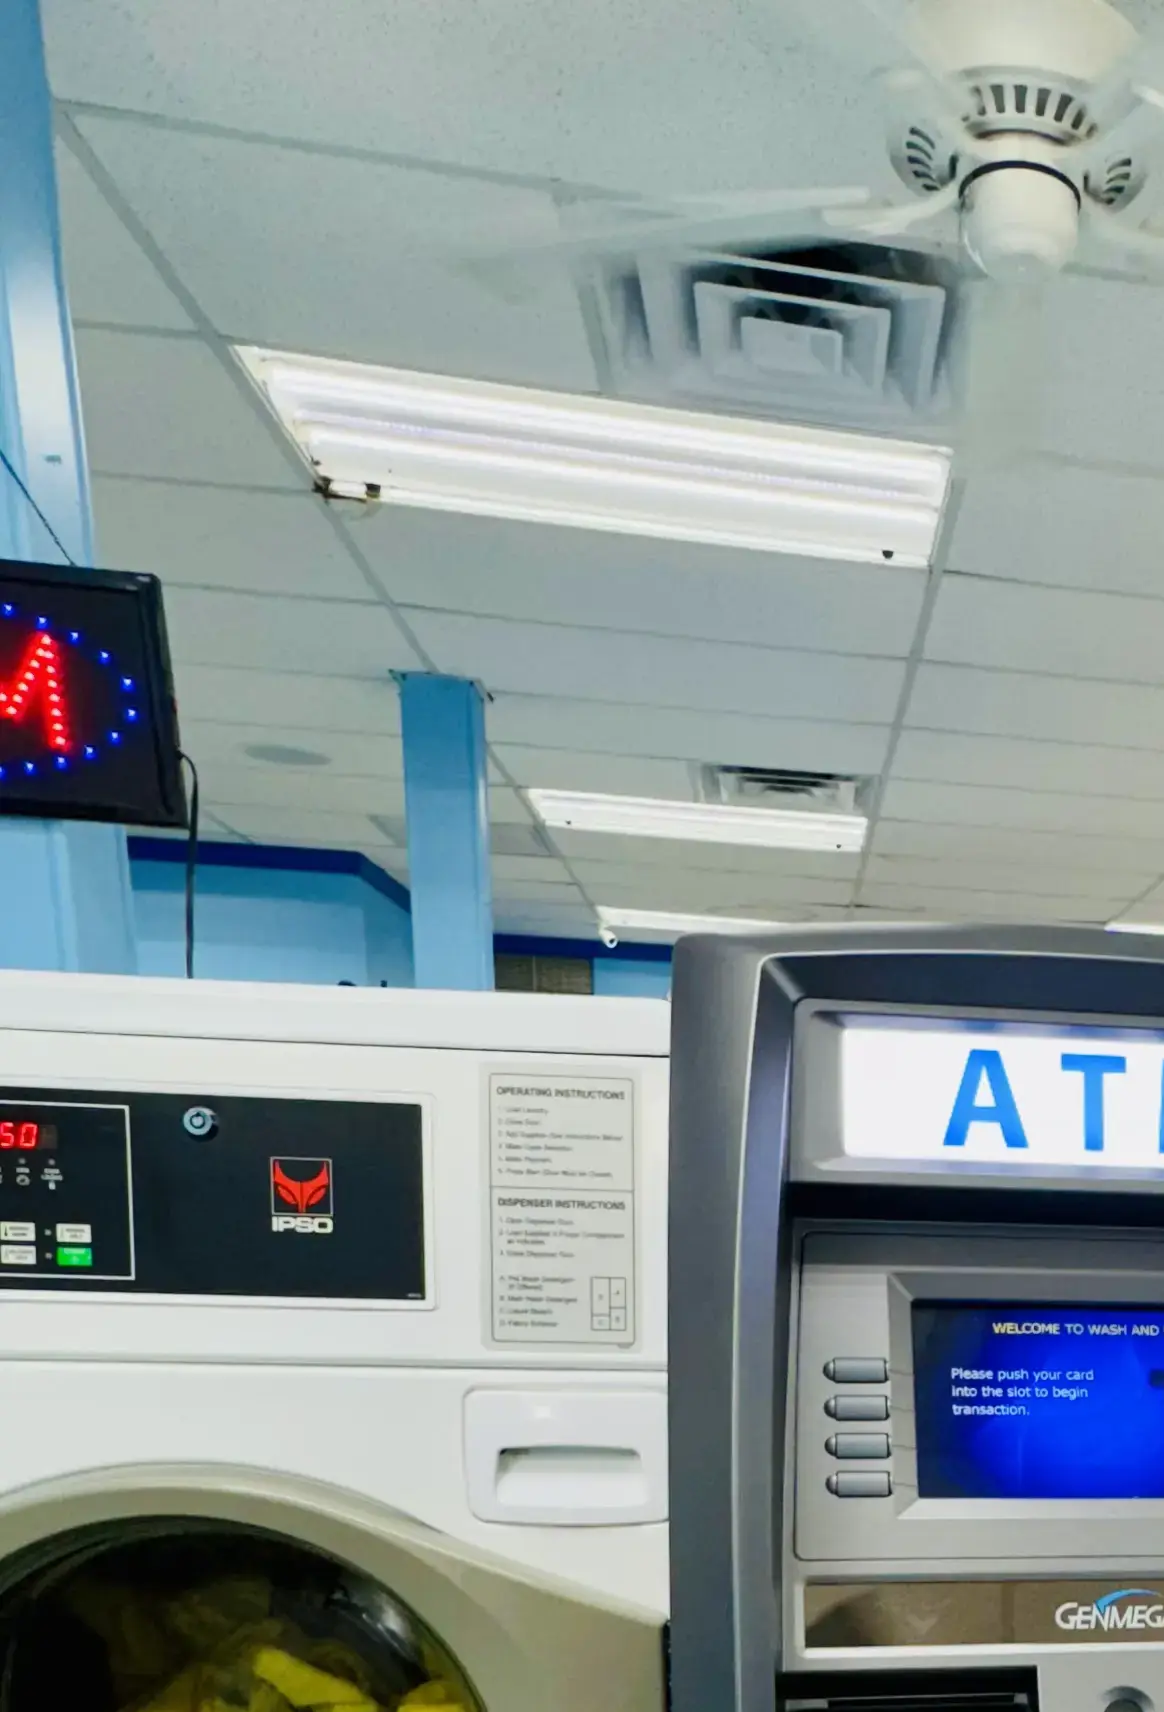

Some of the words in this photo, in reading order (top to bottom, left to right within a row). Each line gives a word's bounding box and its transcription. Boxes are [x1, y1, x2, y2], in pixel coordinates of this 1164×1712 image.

[496, 1086, 552, 1097] OPERATING
[554, 1089, 625, 1100] INSTRUCTIONS
[498, 1197, 553, 1208] DISPENSER
[555, 1200, 626, 1210] INSTRUCTIONS
[271, 1216, 333, 1234] IPSO
[992, 1322, 1060, 1336] WELCOME
[1065, 1323, 1084, 1336] TO
[1088, 1324, 1127, 1336] WASH
[1131, 1325, 1159, 1336] AND
[951, 1368, 993, 1380] Please
[998, 1368, 1028, 1383] push
[1033, 1371, 1060, 1383] your
[1065, 1369, 1094, 1381] card
[951, 1386, 977, 1398] into
[981, 1386, 1003, 1398] the
[1007, 1386, 1031, 1398] slot
[1035, 1387, 1048, 1398] to
[1052, 1386, 1088, 1400] begin
[952, 1403, 1029, 1416] transaction.
